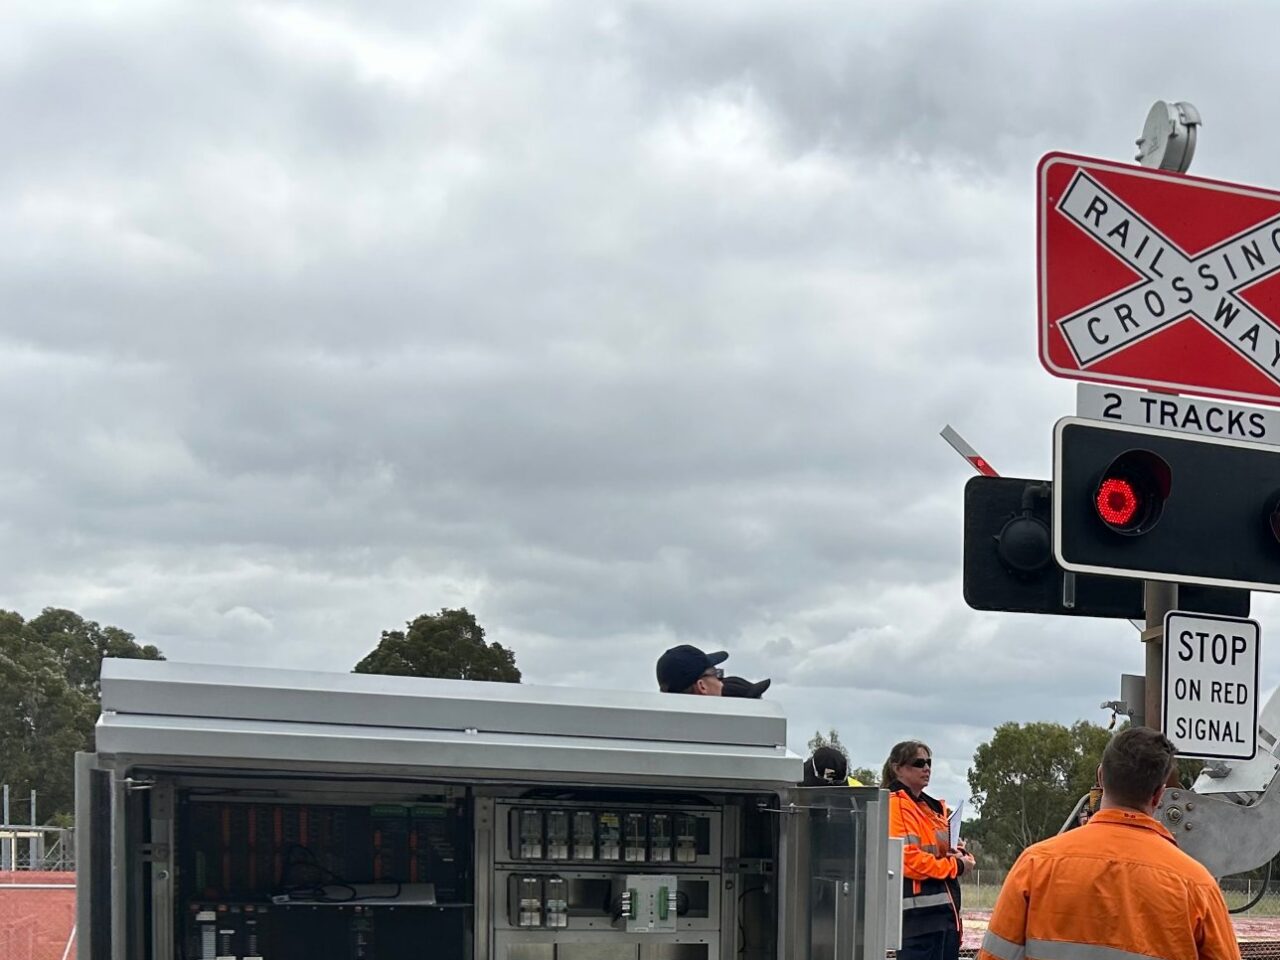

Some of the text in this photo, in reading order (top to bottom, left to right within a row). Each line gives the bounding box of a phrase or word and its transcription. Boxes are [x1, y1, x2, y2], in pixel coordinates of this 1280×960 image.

[1083, 195, 1164, 279] RAIL
[1102, 393, 1266, 438] 2 TRACKS
[1178, 630, 1247, 666] STOP
[1175, 678, 1248, 705] ON RED
[1175, 717, 1246, 744] SIGNAL
